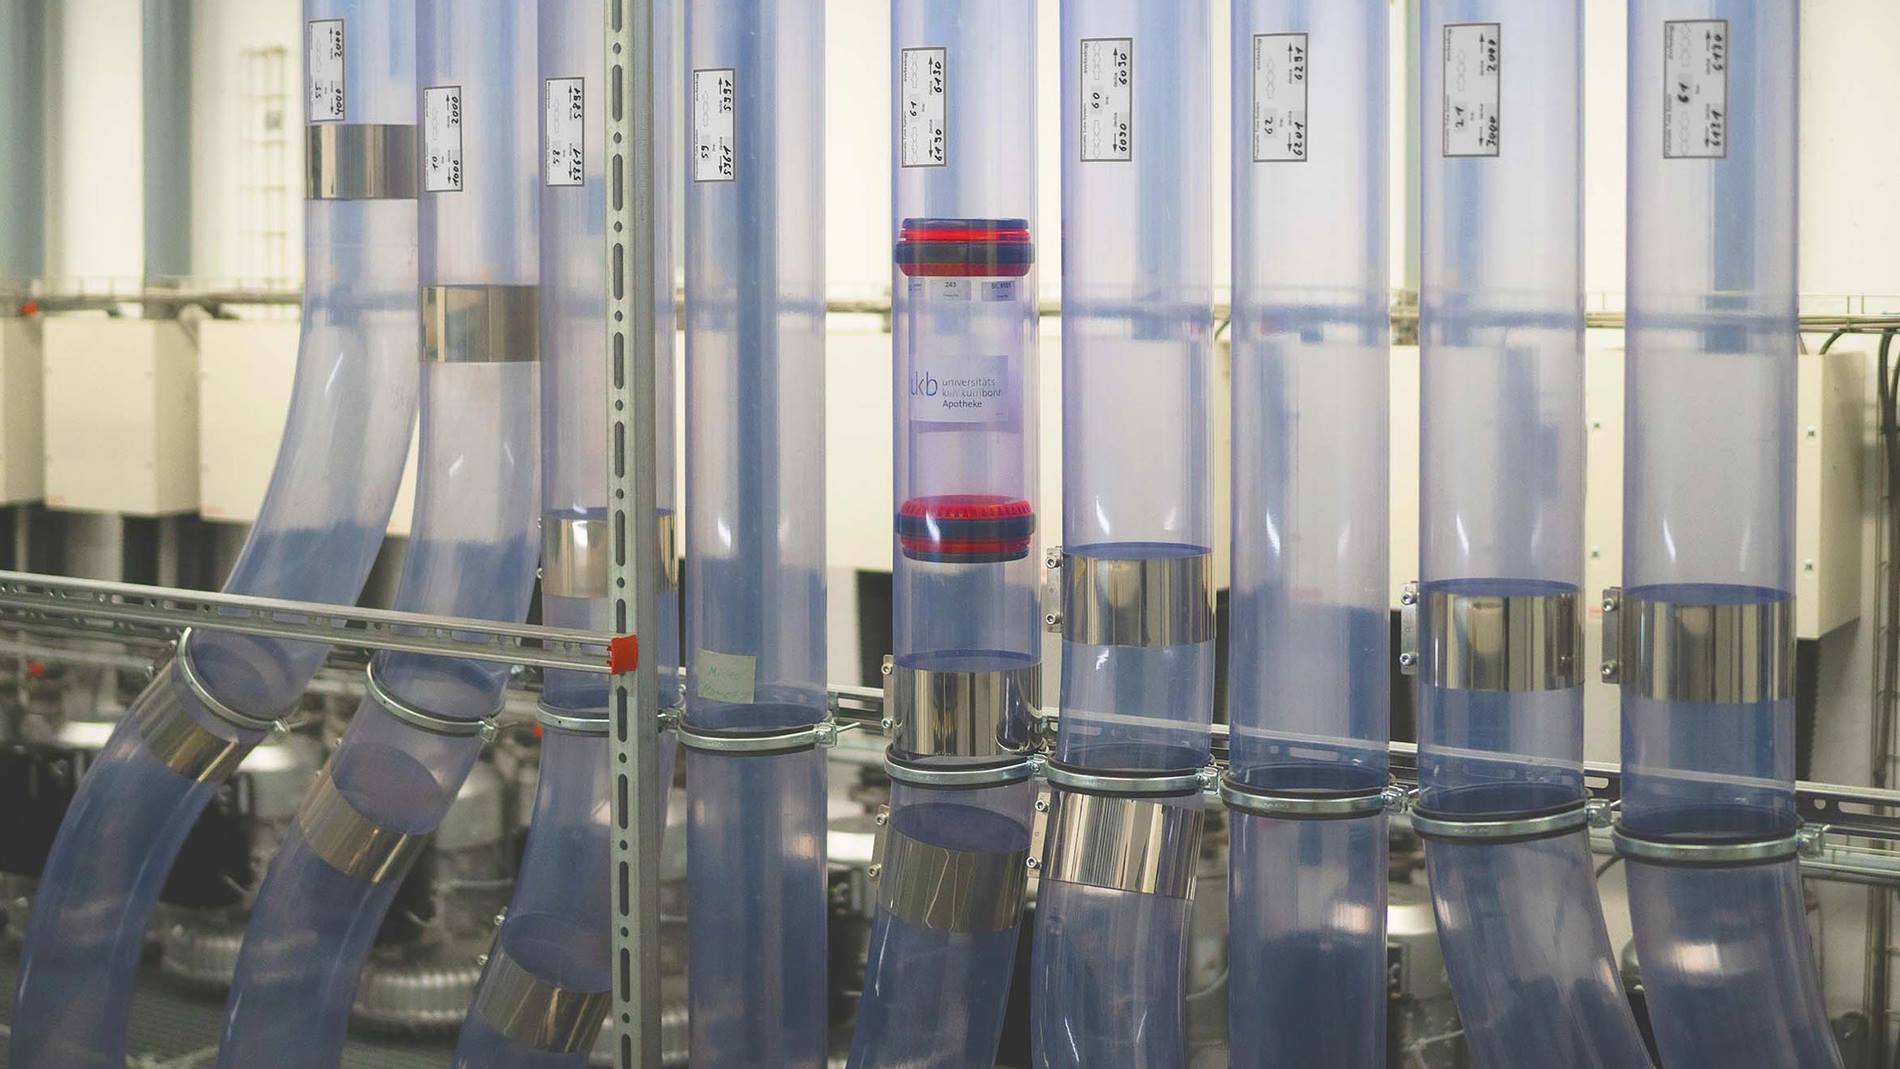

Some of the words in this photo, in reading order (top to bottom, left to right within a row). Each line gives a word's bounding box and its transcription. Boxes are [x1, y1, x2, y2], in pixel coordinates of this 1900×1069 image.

[1092, 92, 1100, 109] 60
[1678, 82, 1689, 103] 61
[573, 88, 582, 119] 5891
[910, 101, 916, 117] 61
[1265, 117, 1273, 134] 62
[1455, 106, 1464, 128] 21
[1293, 122, 1303, 156] 6201
[701, 145, 709, 159] 59
[723, 145, 731, 175] 5961
[432, 156, 438, 170] 10
[573, 148, 581, 181] 5861
[942, 400, 983, 409] Apotheke
